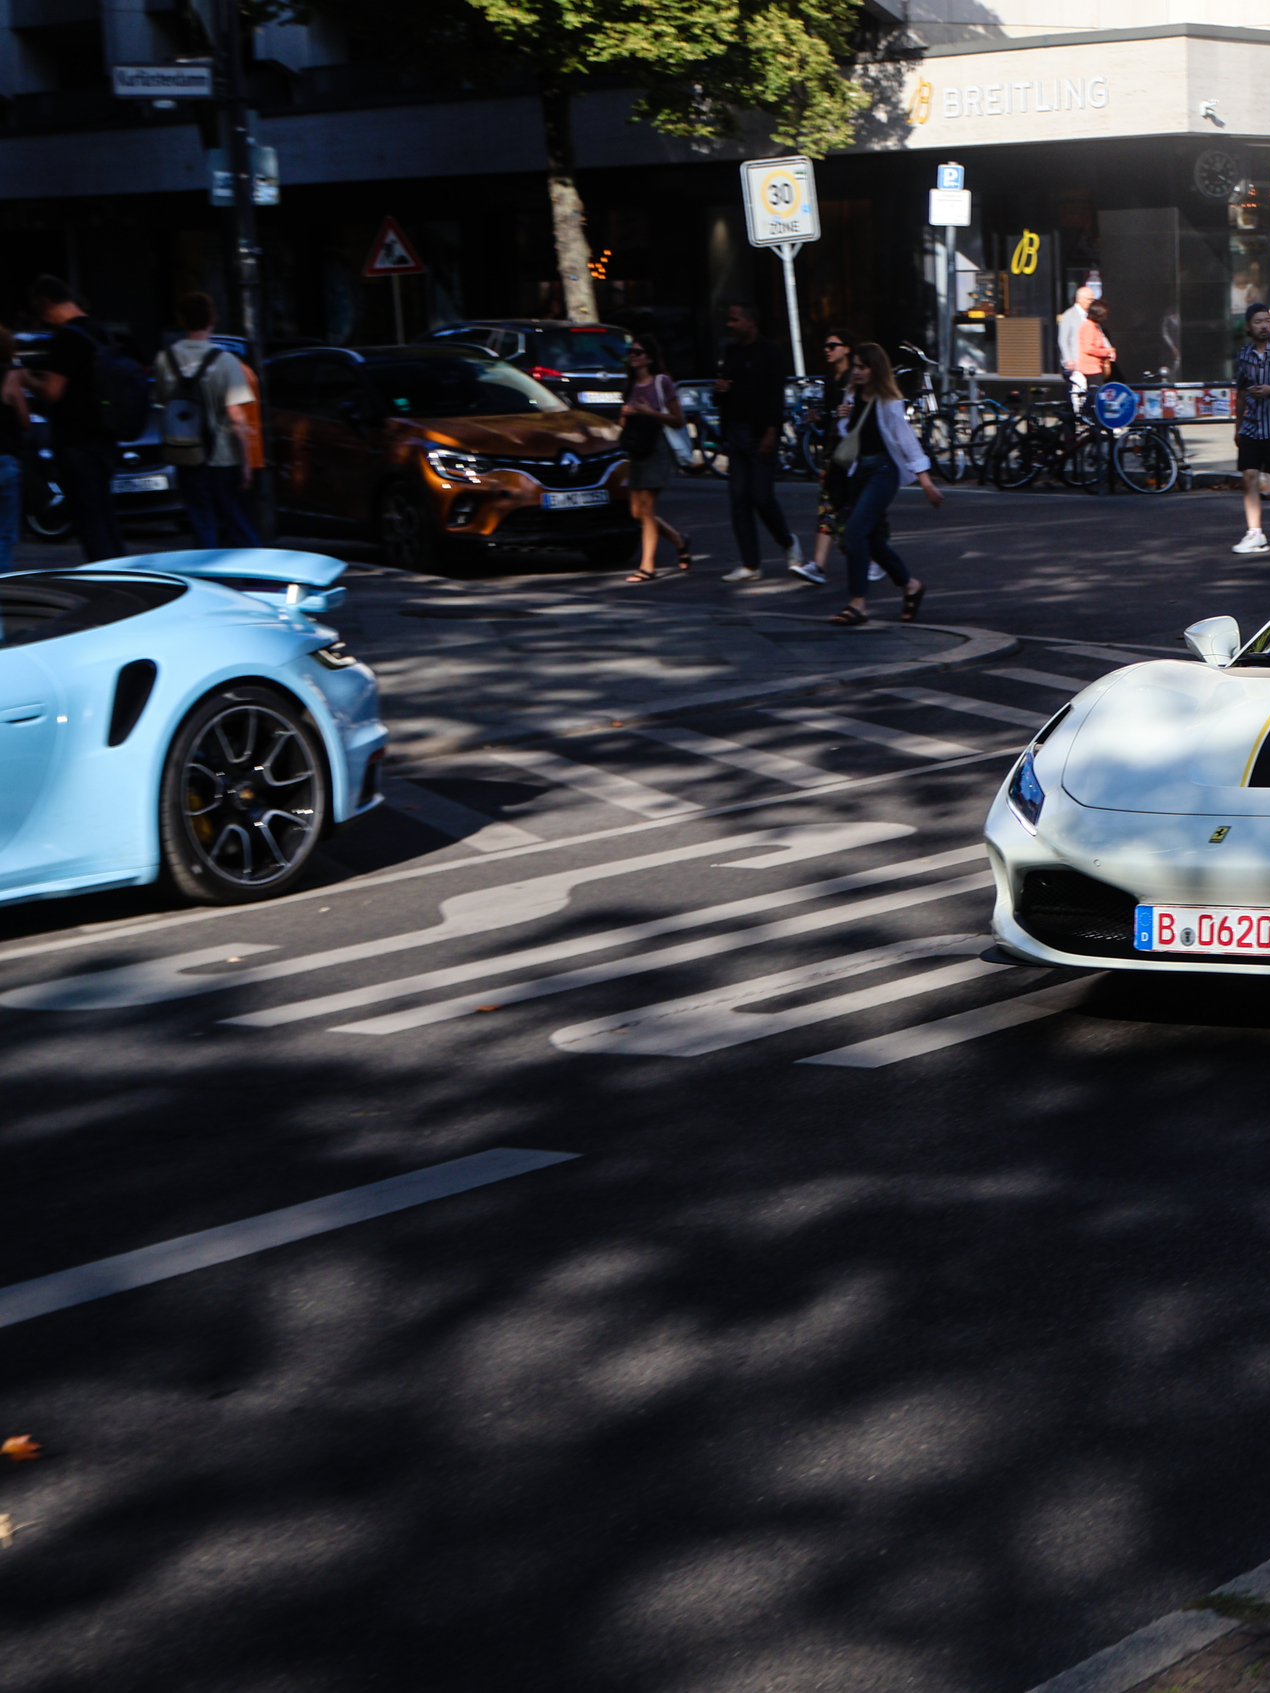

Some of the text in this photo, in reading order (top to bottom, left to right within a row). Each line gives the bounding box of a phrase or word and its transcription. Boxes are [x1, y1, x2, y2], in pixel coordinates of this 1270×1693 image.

[945, 76, 1110, 119] BREITLING
[943, 168, 959, 187] P
[768, 182, 794, 206] 30
[770, 220, 800, 235] ZONE
[1140, 931, 1149, 943] D
[1158, 912, 1176, 945] B
